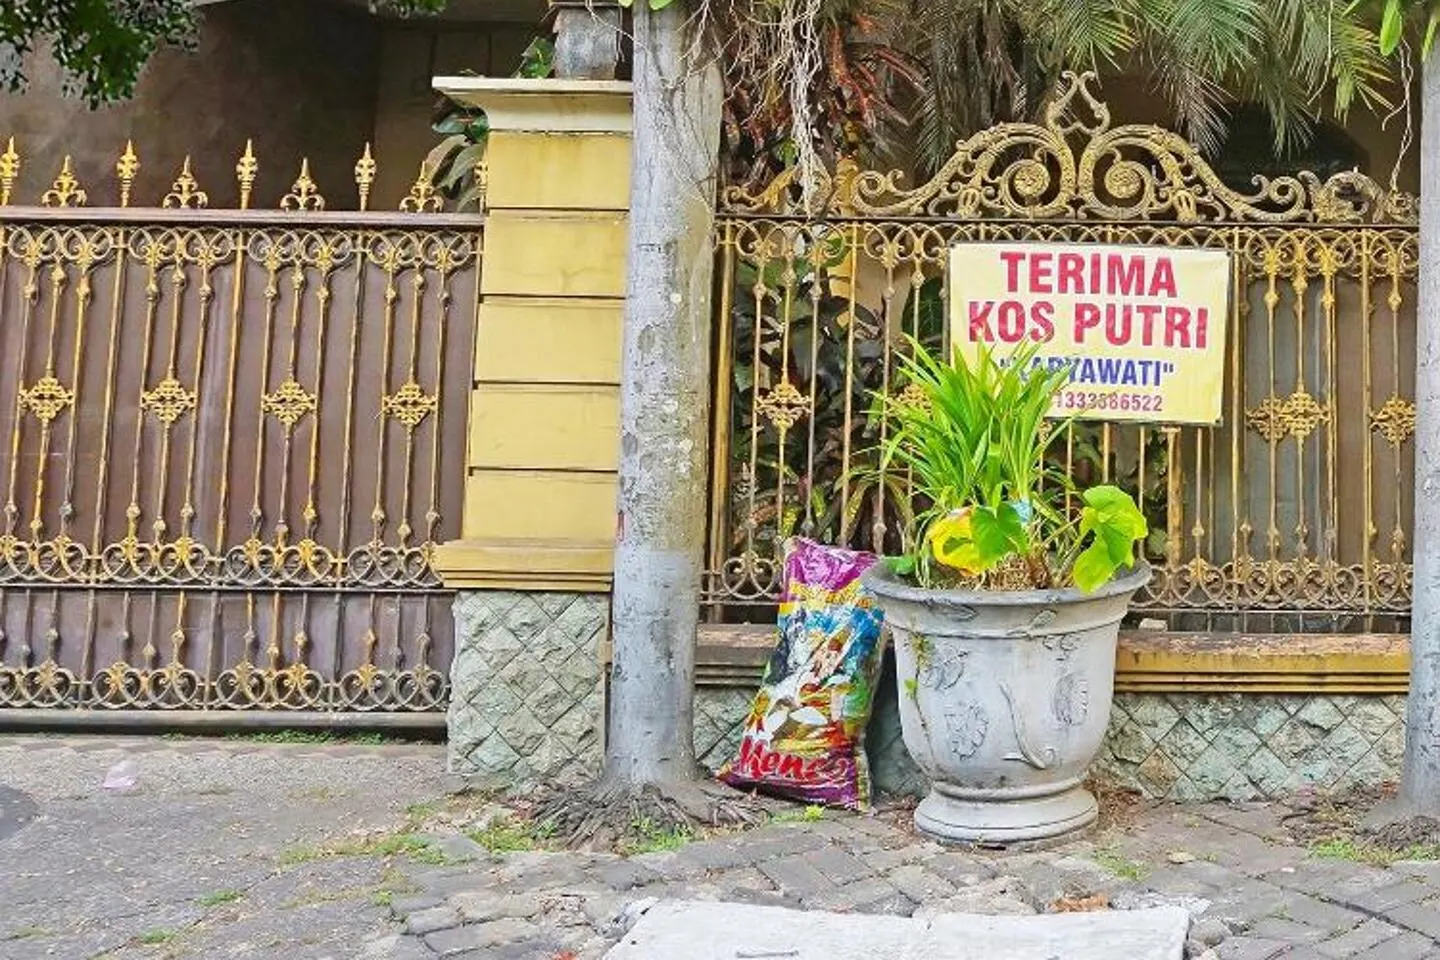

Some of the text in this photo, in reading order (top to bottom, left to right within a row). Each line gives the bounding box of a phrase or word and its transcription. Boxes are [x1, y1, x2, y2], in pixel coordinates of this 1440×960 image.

[1000, 251, 1178, 298] TERIMA
[968, 300, 1209, 349] KOS PUTRI
